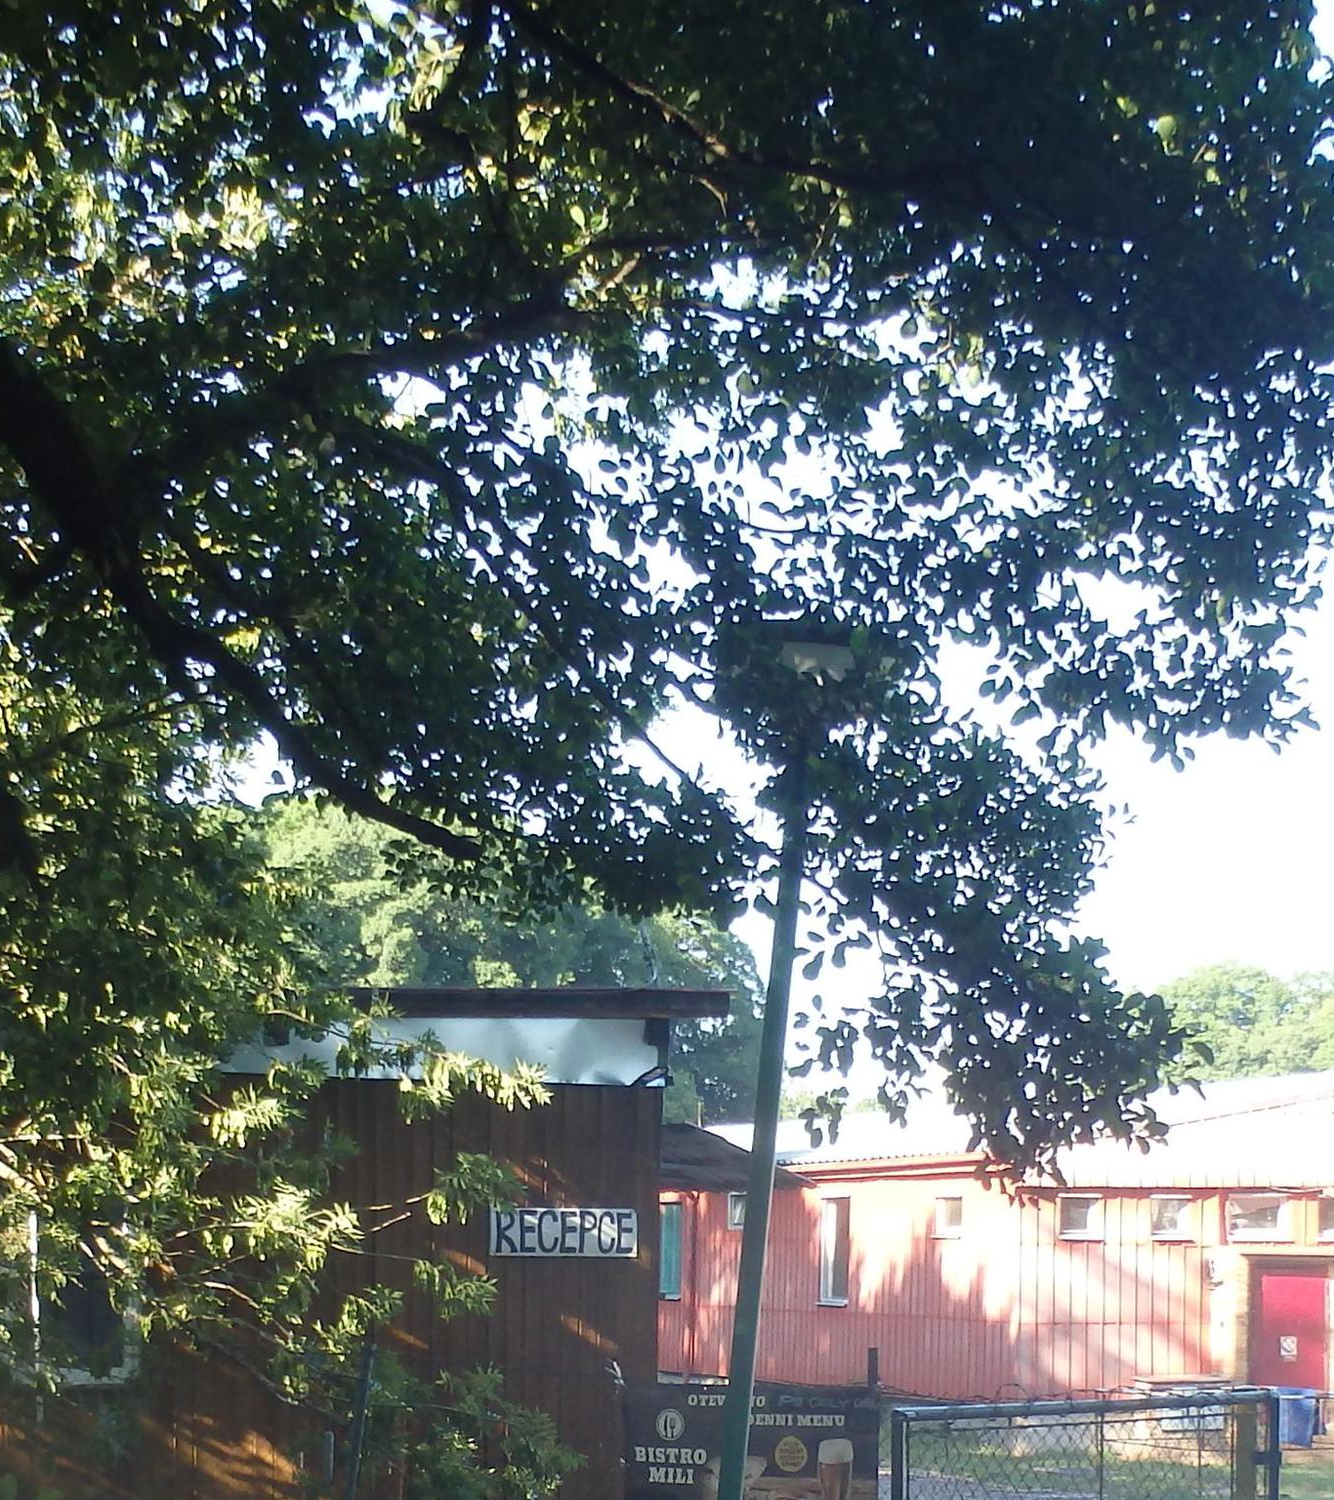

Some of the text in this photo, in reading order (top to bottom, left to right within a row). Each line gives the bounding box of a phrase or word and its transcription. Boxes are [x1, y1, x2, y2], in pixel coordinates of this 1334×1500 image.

[496, 1209, 633, 1254] RECEPCE
[797, 1414, 846, 1427] MENU
[634, 1446, 707, 1465] BISTRO
[648, 1466, 695, 1485] MILI
